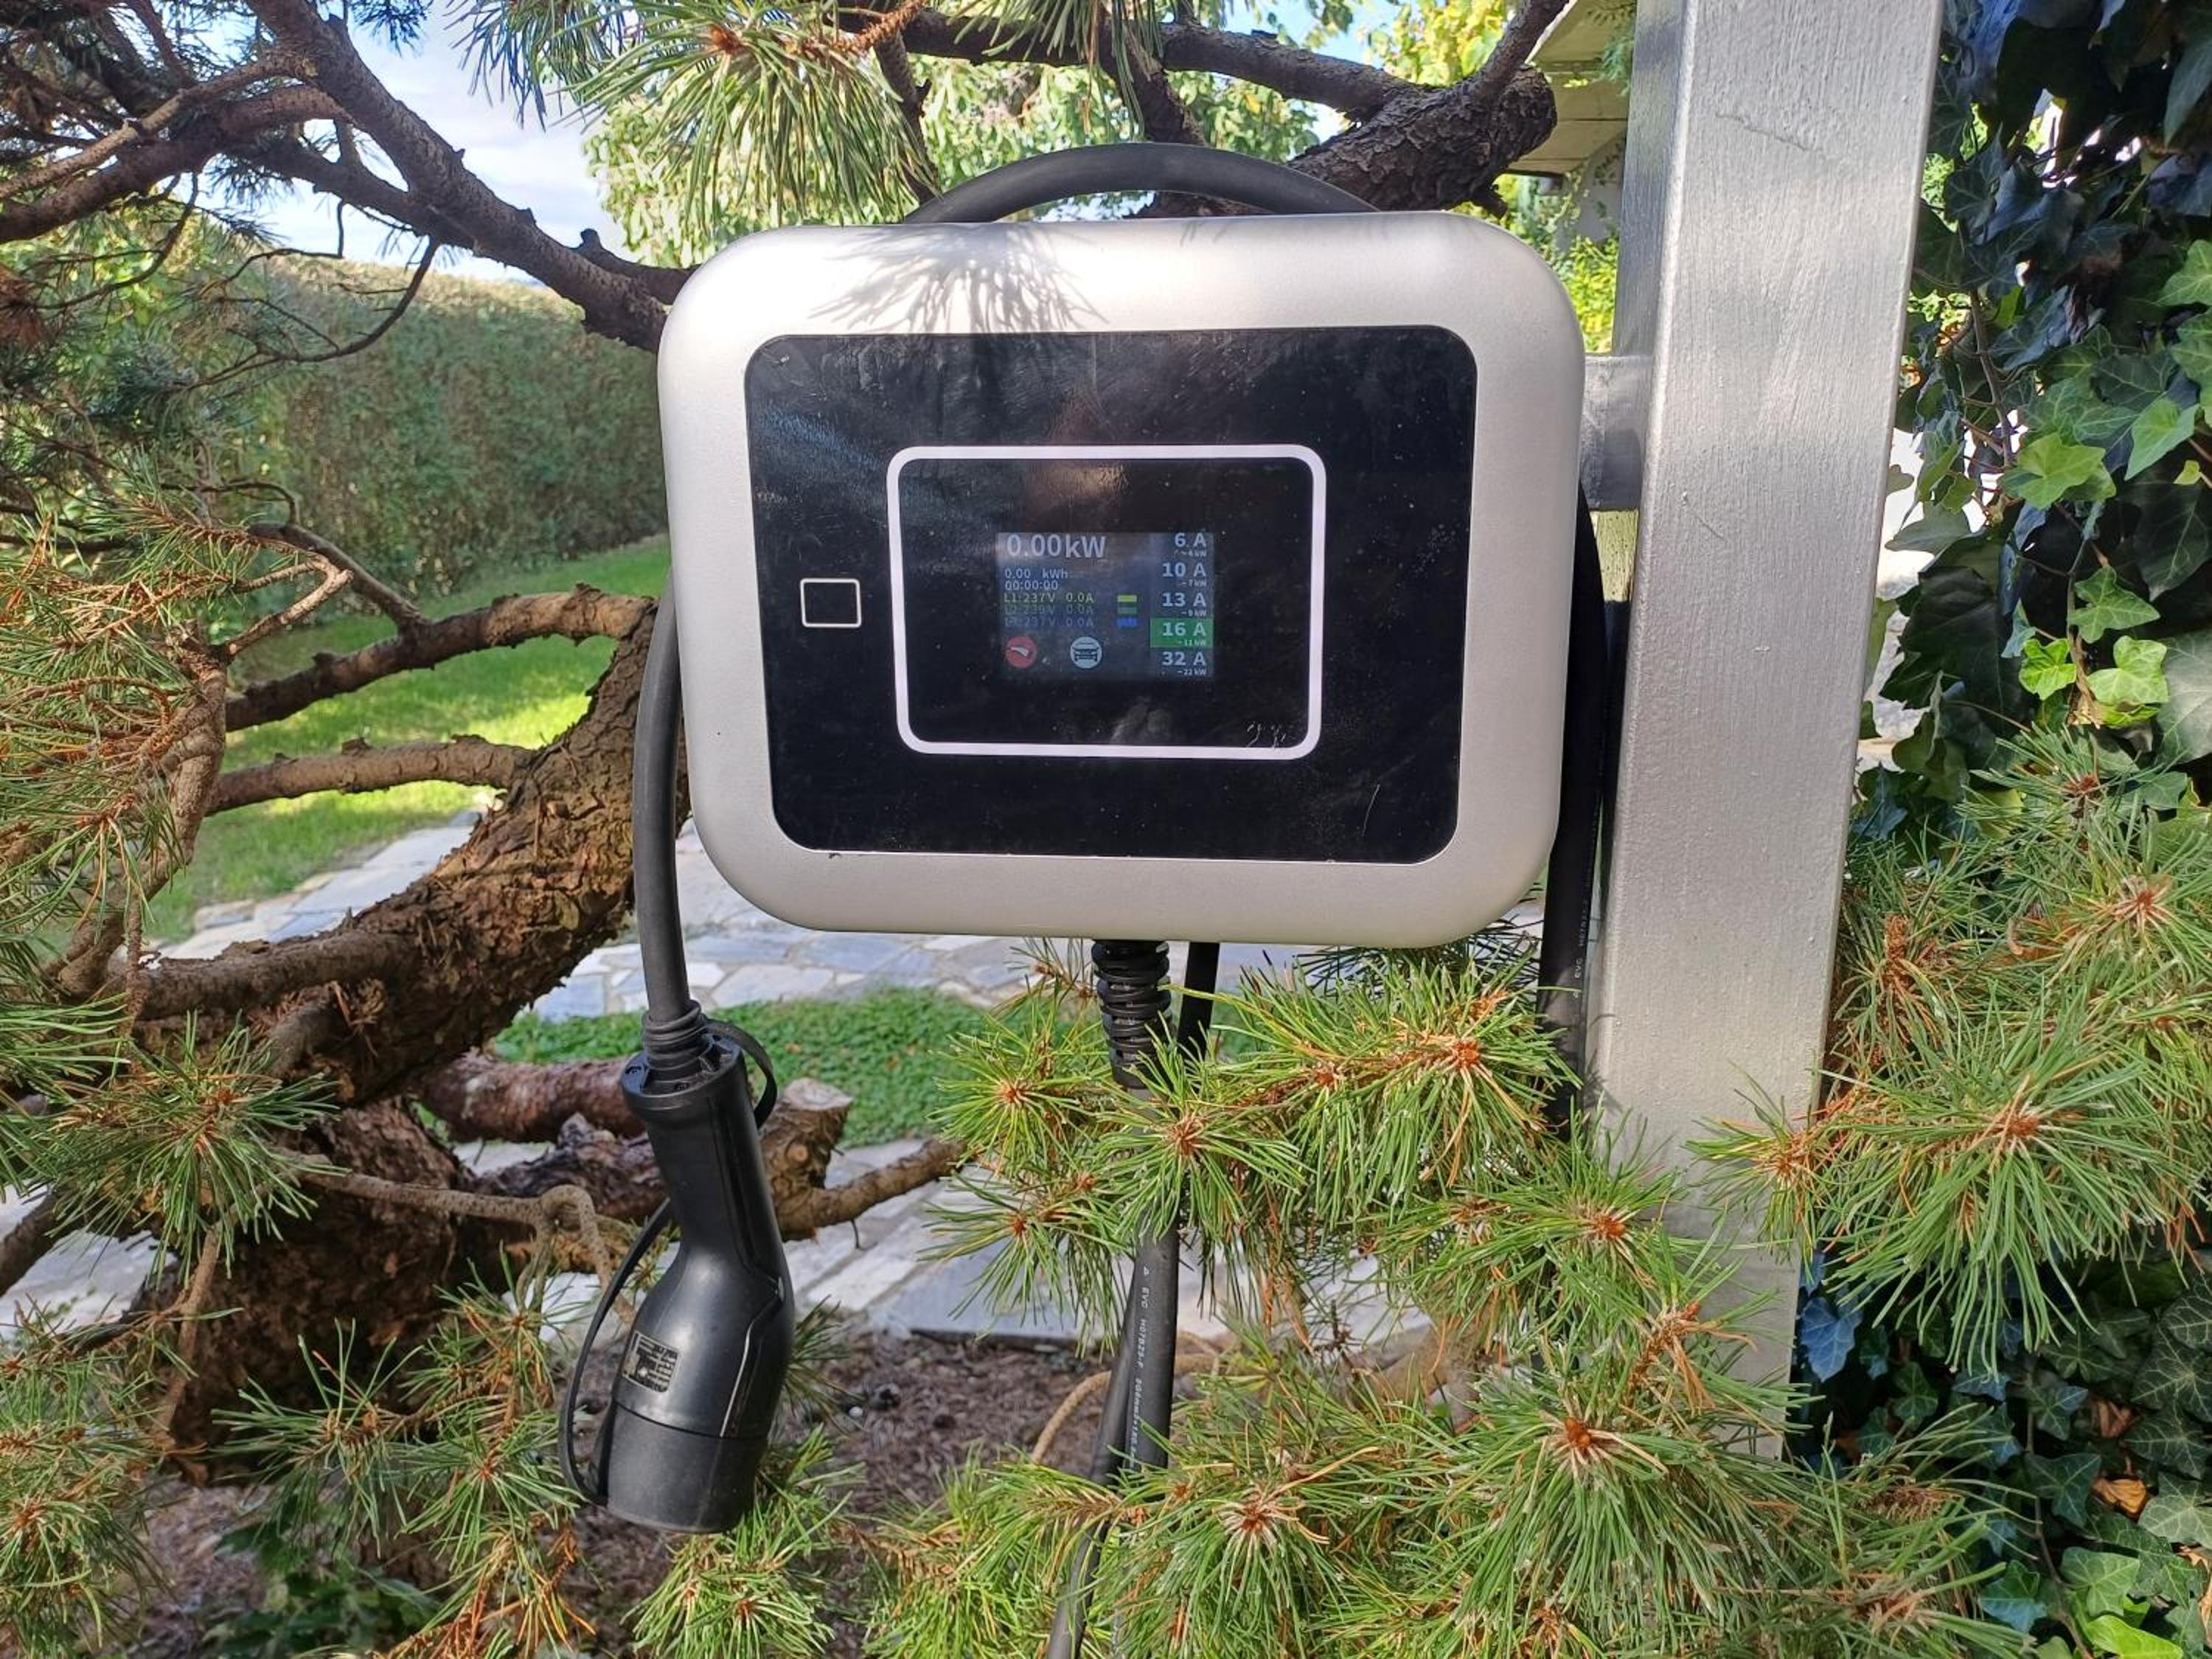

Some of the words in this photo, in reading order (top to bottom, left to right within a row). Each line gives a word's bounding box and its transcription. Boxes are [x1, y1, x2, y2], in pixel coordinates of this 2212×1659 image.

[1175, 532, 1186, 547] 6
[1193, 532, 1207, 547] A
[1004, 568, 1032, 579] 0.00
[1042, 568, 1068, 579] kWh
[1162, 563, 1186, 577] 10
[1193, 563, 1206, 577] A
[1005, 580, 1059, 591] 00:00:00
[1065, 592, 1095, 603] 0.0A
[1162, 592, 1186, 607] 13
[1193, 592, 1207, 607] A
[1162, 622, 1186, 636] 16
[1193, 622, 1206, 636] A
[1162, 651, 1186, 666] 32
[1193, 651, 1206, 666] A
